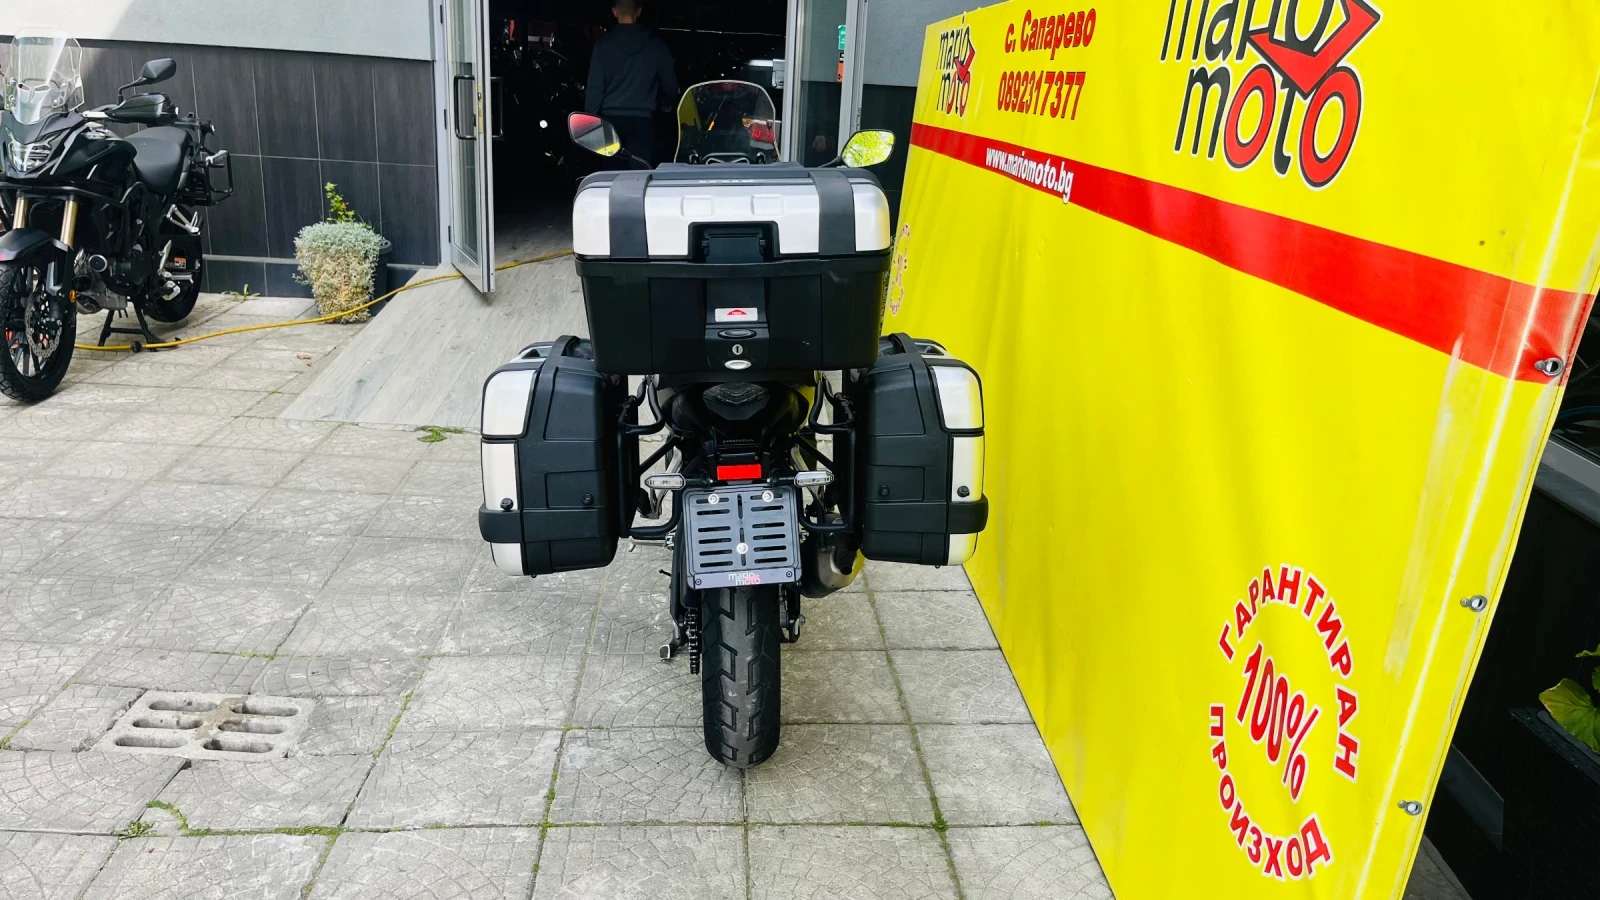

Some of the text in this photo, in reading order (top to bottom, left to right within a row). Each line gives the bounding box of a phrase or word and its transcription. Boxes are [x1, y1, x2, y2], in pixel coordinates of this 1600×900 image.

[936, 15, 970, 70] mario
[1020, 8, 1096, 60] Сапарево
[936, 71, 971, 118] moto
[998, 70, 1086, 120] 0892317377
[1174, 63, 1362, 188] moto
[985, 147, 1074, 205] www.mariomoto.bg
[1218, 565, 1359, 780] ГАРАНТИРАН
[1236, 643, 1319, 800] 100%
[1209, 705, 1331, 878] ПРОИЗХОД
